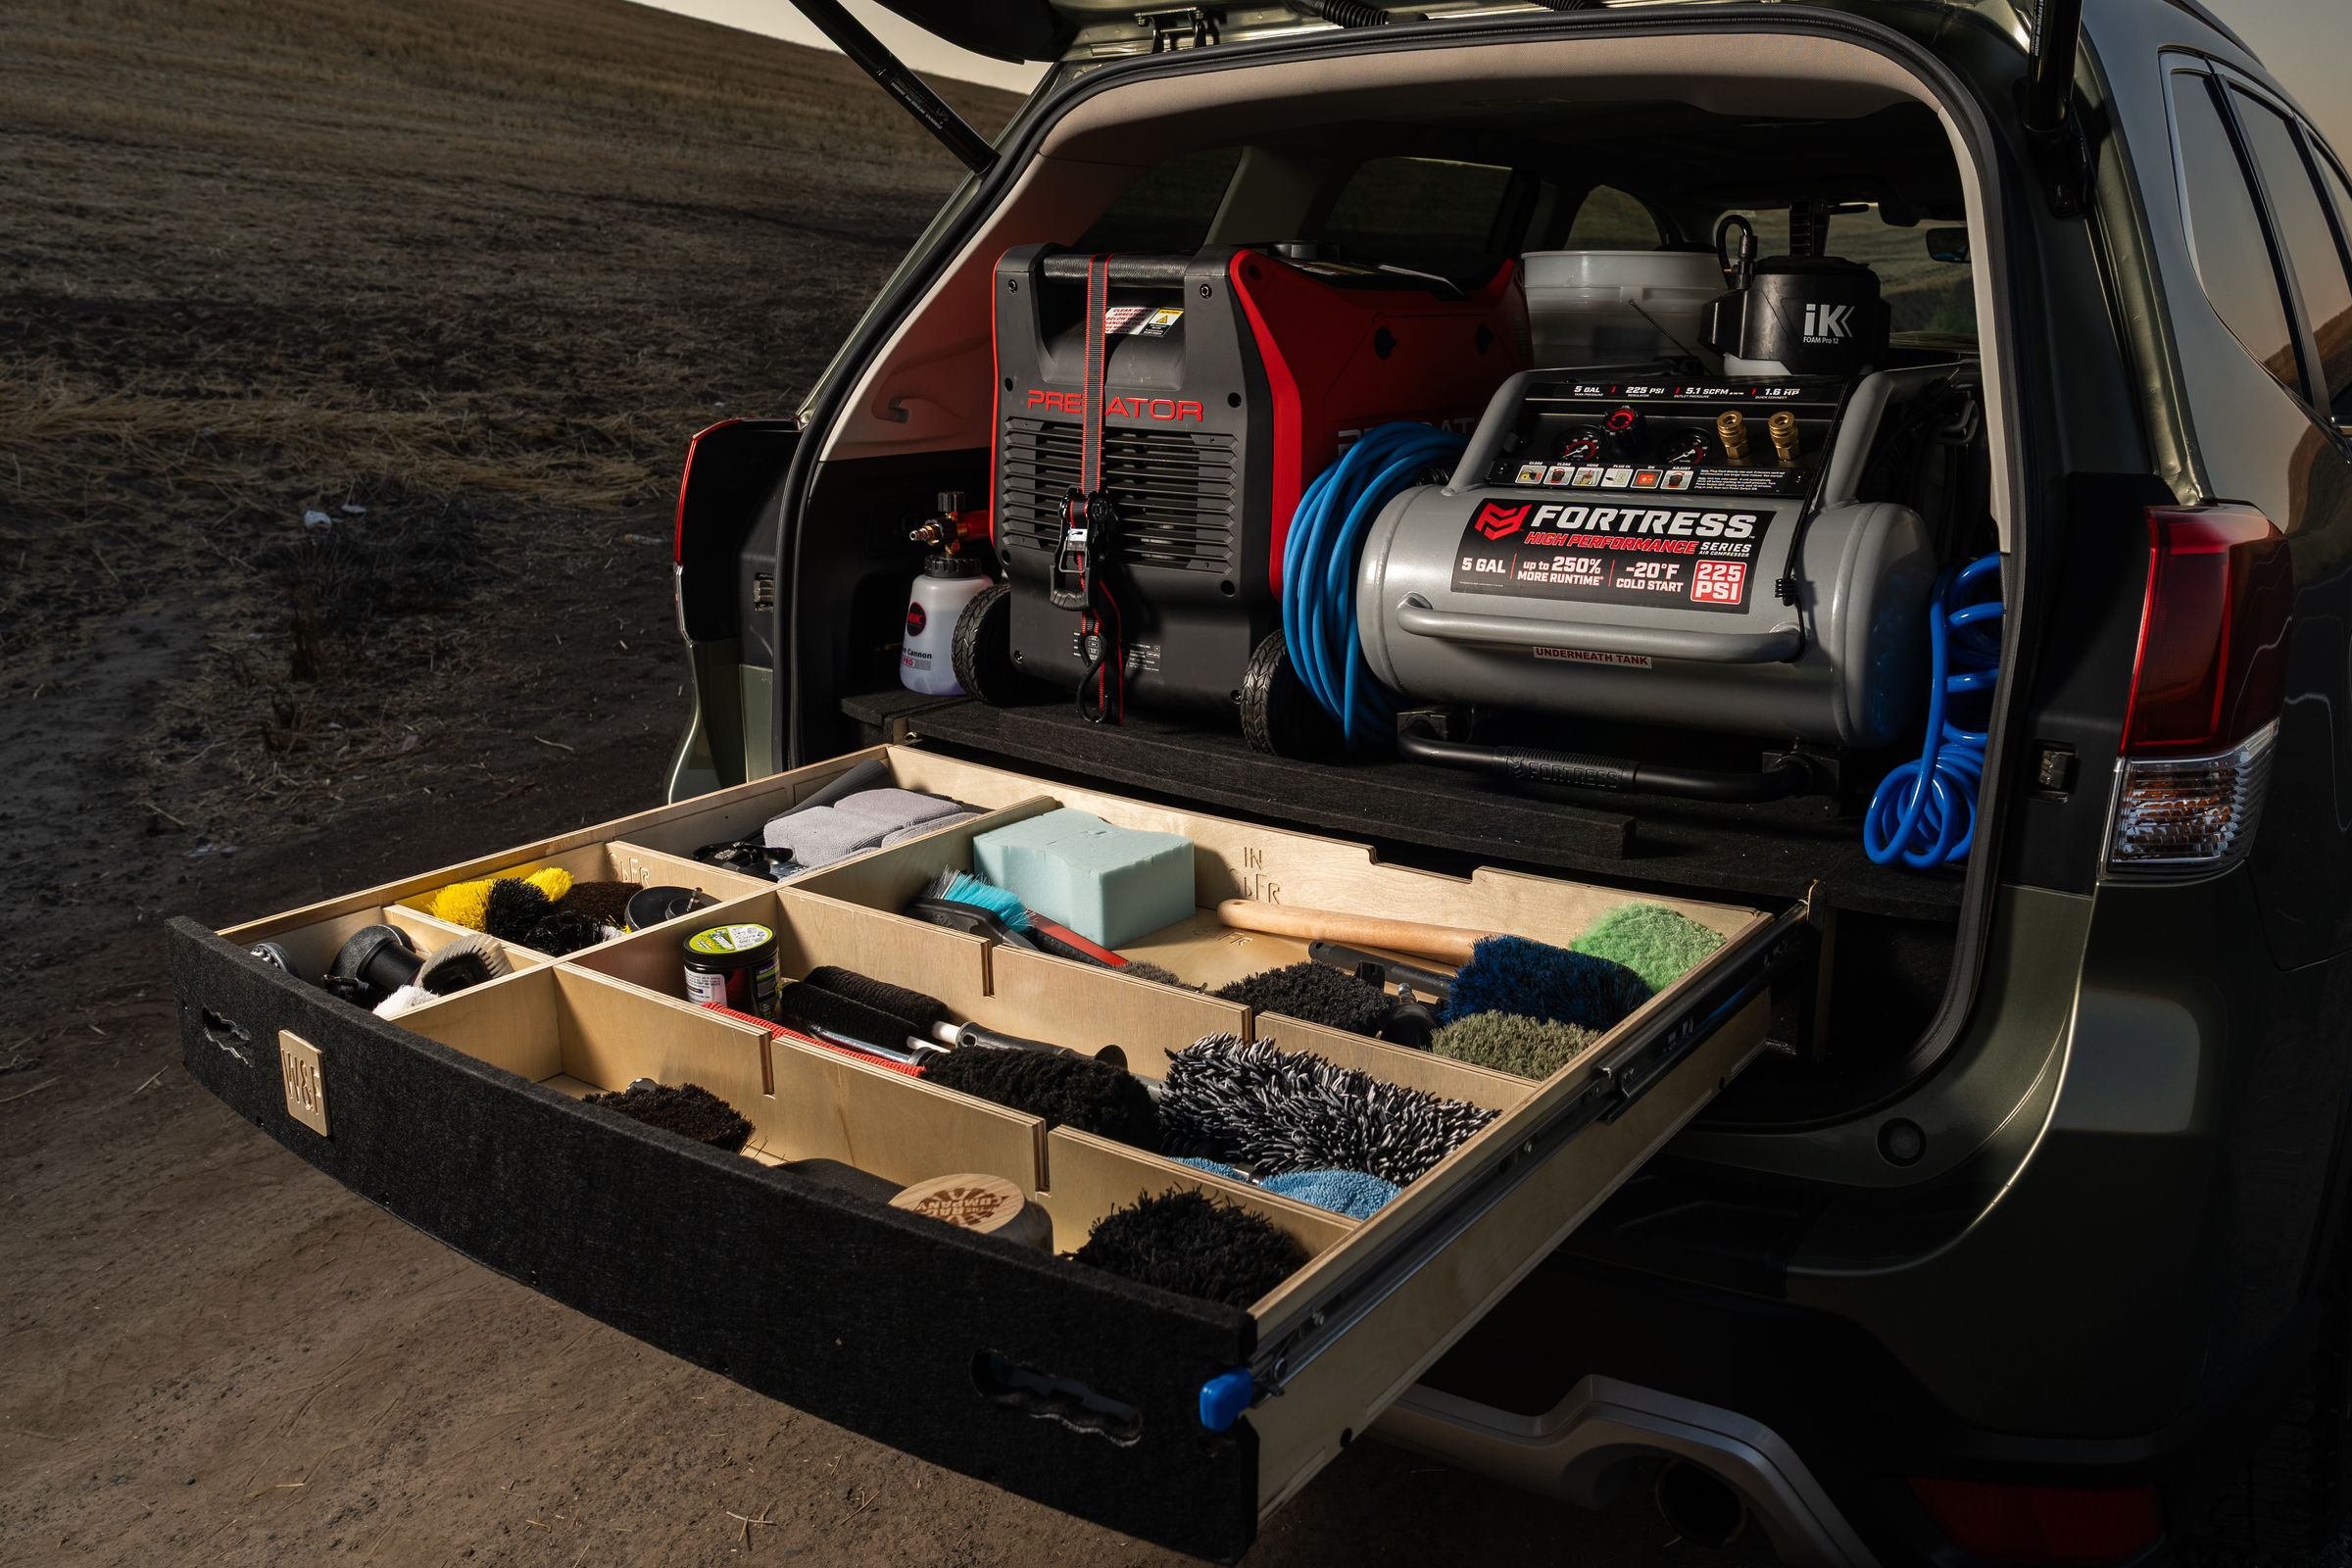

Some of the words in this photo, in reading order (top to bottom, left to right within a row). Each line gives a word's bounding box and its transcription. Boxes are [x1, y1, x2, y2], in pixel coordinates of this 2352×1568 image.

[1028, 389, 1203, 422] PREATOR
[1530, 505, 1757, 539] FORTRESS
[1524, 531, 1567, 547] HIGH
[1567, 532, 1699, 555] PERFORMANCE
[1699, 541, 1752, 553] SERIES
[1461, 557, 1474, 571] 5
[1475, 558, 1506, 573] GAL
[1523, 561, 1537, 571] up
[1538, 560, 1549, 571] to
[1551, 556, 1601, 574] 250%
[1626, 562, 1681, 580] -20°F
[1697, 564, 1742, 582] 225
[1517, 570, 1548, 582] MORE
[1616, 577, 1646, 590] COLD
[1646, 580, 1685, 593] START
[1694, 580, 1738, 601] PSI
[906, 648, 932, 660] Cannon
[1536, 648, 1613, 662] UNDERNEATH
[1616, 655, 1649, 665] TANK
[915, 1196, 1004, 1211] COMPANY
